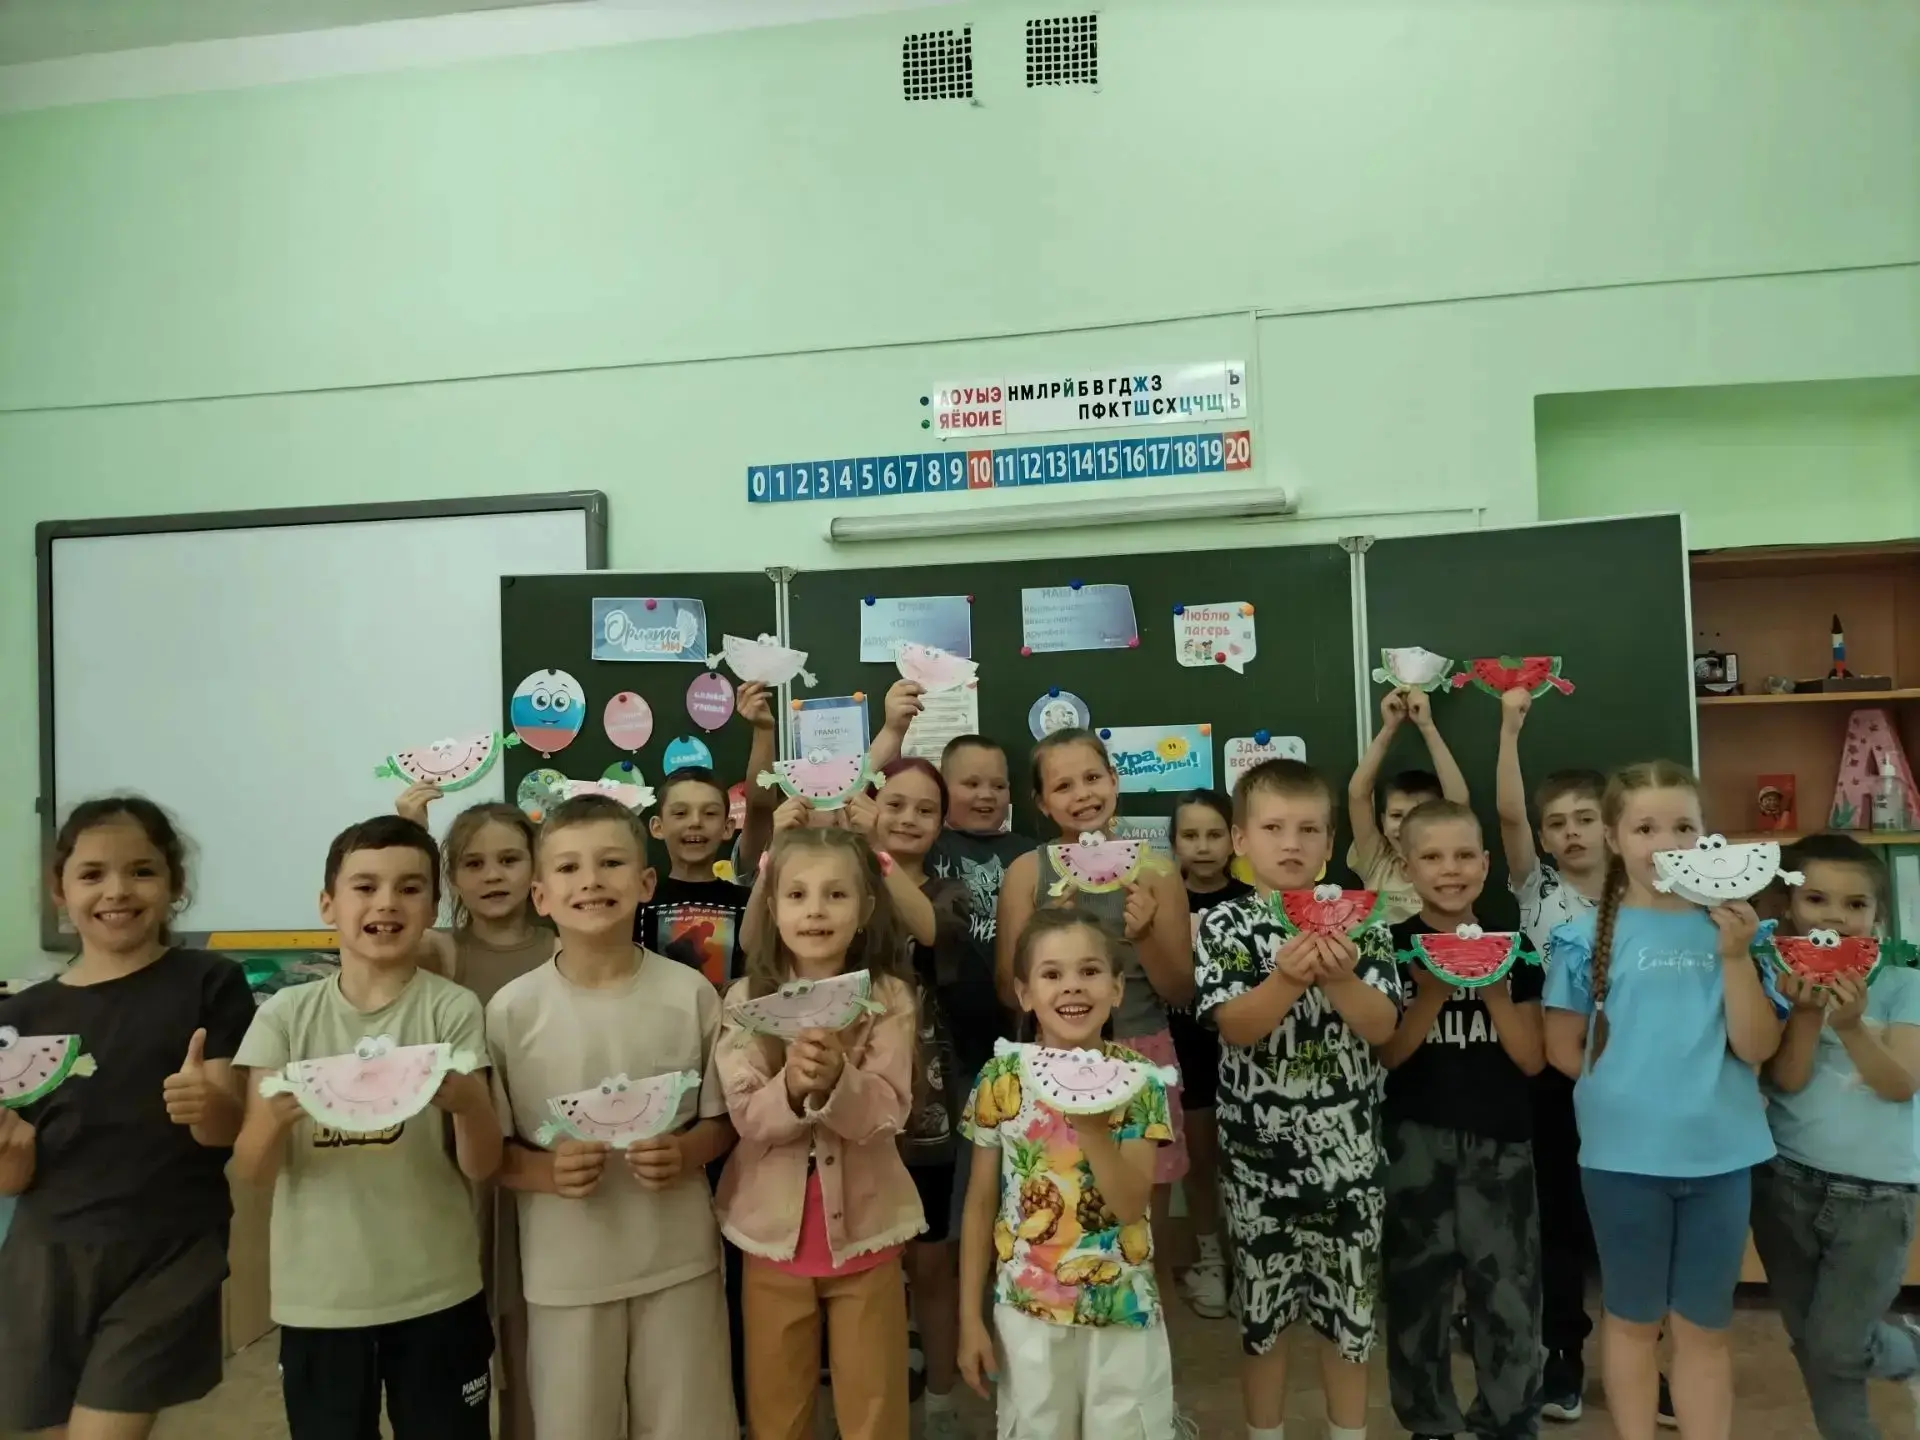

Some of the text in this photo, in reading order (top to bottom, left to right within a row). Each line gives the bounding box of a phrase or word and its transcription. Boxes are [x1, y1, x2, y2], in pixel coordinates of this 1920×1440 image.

[752, 436, 1250, 497] 0 1 2 3 4 5 6 7 8 9 10 11 12 13 14 15 16 17 18 19 20
[1182, 608, 1230, 621] Люблю
[1184, 625, 1231, 639] лагерь
[1116, 751, 1200, 777] аникулы!
[1121, 826, 1169, 840] ДИПЛО
[1426, 1010, 1498, 1049] АЦА
